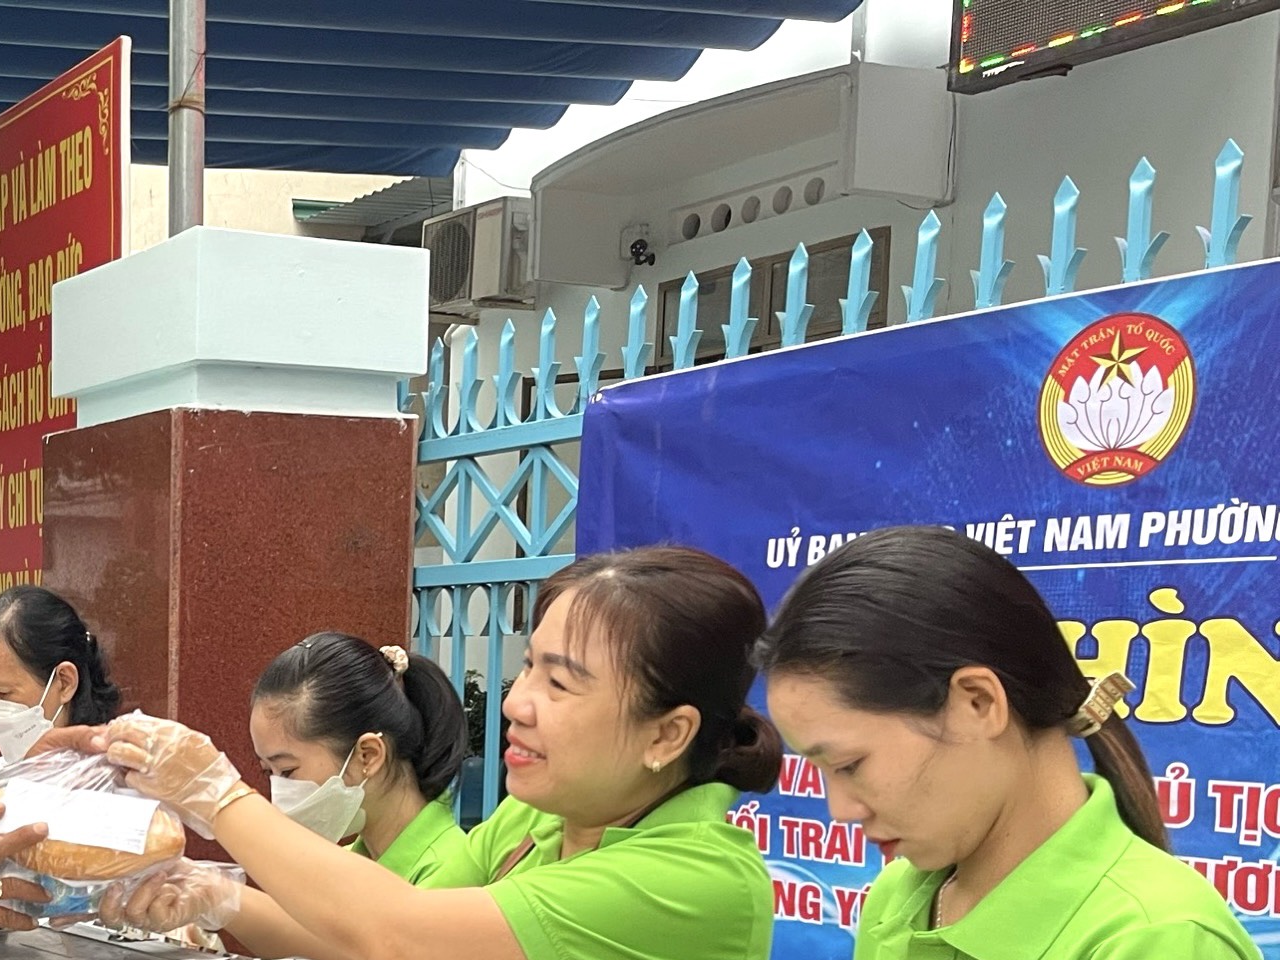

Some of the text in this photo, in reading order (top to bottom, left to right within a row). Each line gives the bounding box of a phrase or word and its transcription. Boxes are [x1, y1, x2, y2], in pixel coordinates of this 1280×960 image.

[10, 152, 28, 225] VÀ
[29, 139, 57, 217] LÀM
[59, 125, 93, 201] THEO
[27, 343, 44, 425] HỒ
[7, 457, 28, 528] CHÍ
[1076, 455, 1144, 477] VIỆT NAM
[1043, 513, 1131, 553] NAM
[1138, 497, 1280, 549] PHƯỜN
